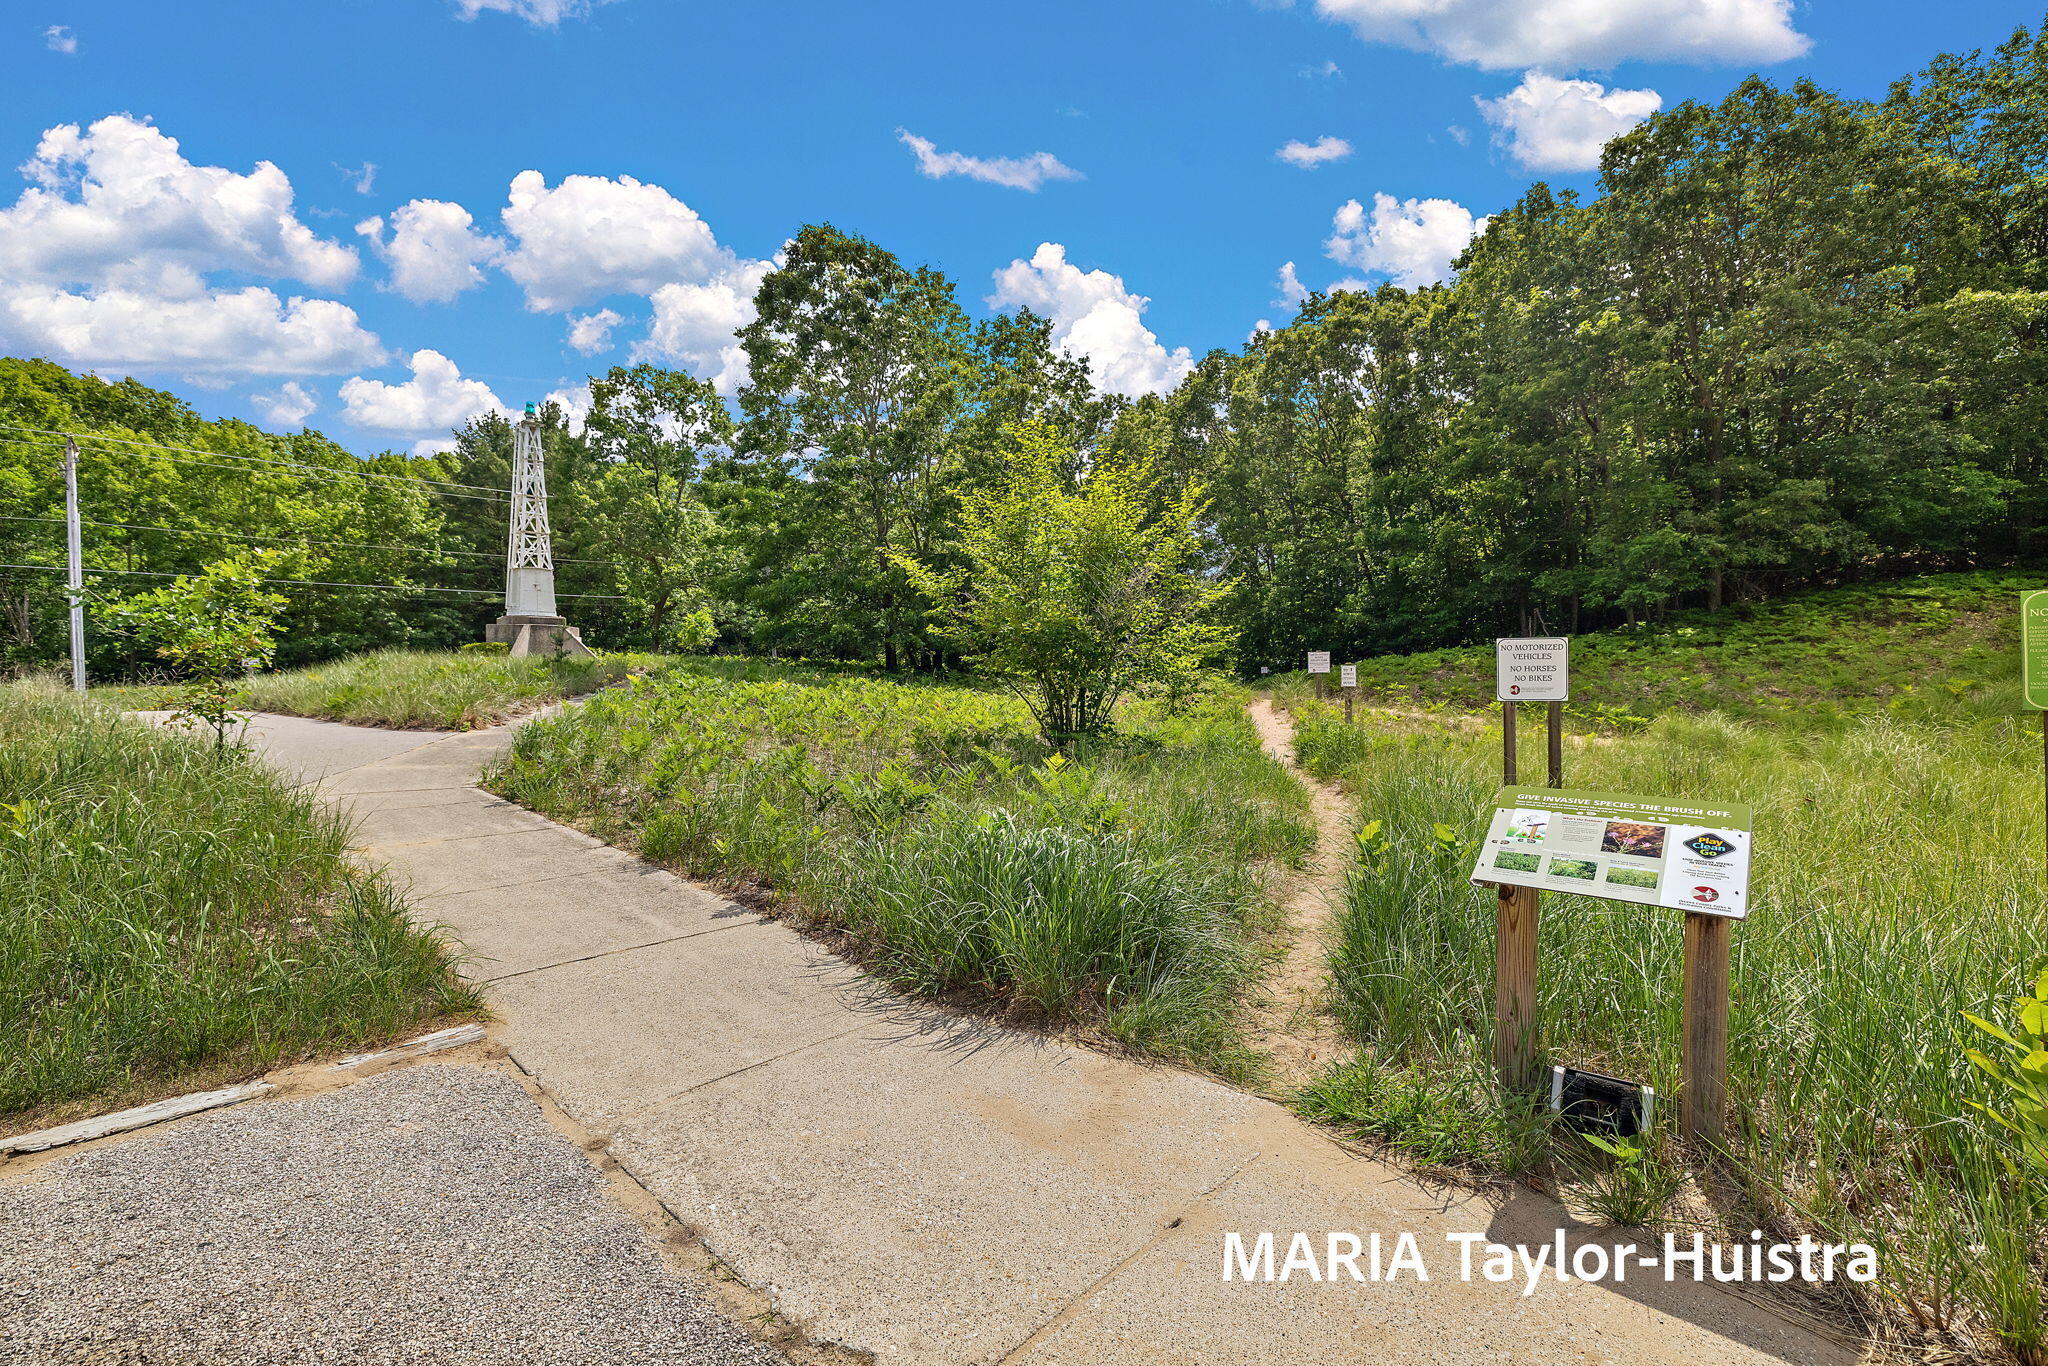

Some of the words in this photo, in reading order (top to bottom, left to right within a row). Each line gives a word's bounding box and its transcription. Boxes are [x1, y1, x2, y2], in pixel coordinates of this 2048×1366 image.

[1542, 796, 1591, 805] INVASIVE
[1593, 800, 1637, 809] SPECIES
[1664, 806, 1704, 815] BRUSH
[1706, 810, 1732, 818] OFF.
[1692, 842, 1726, 852] Clean
[1698, 837, 1724, 847] Play
